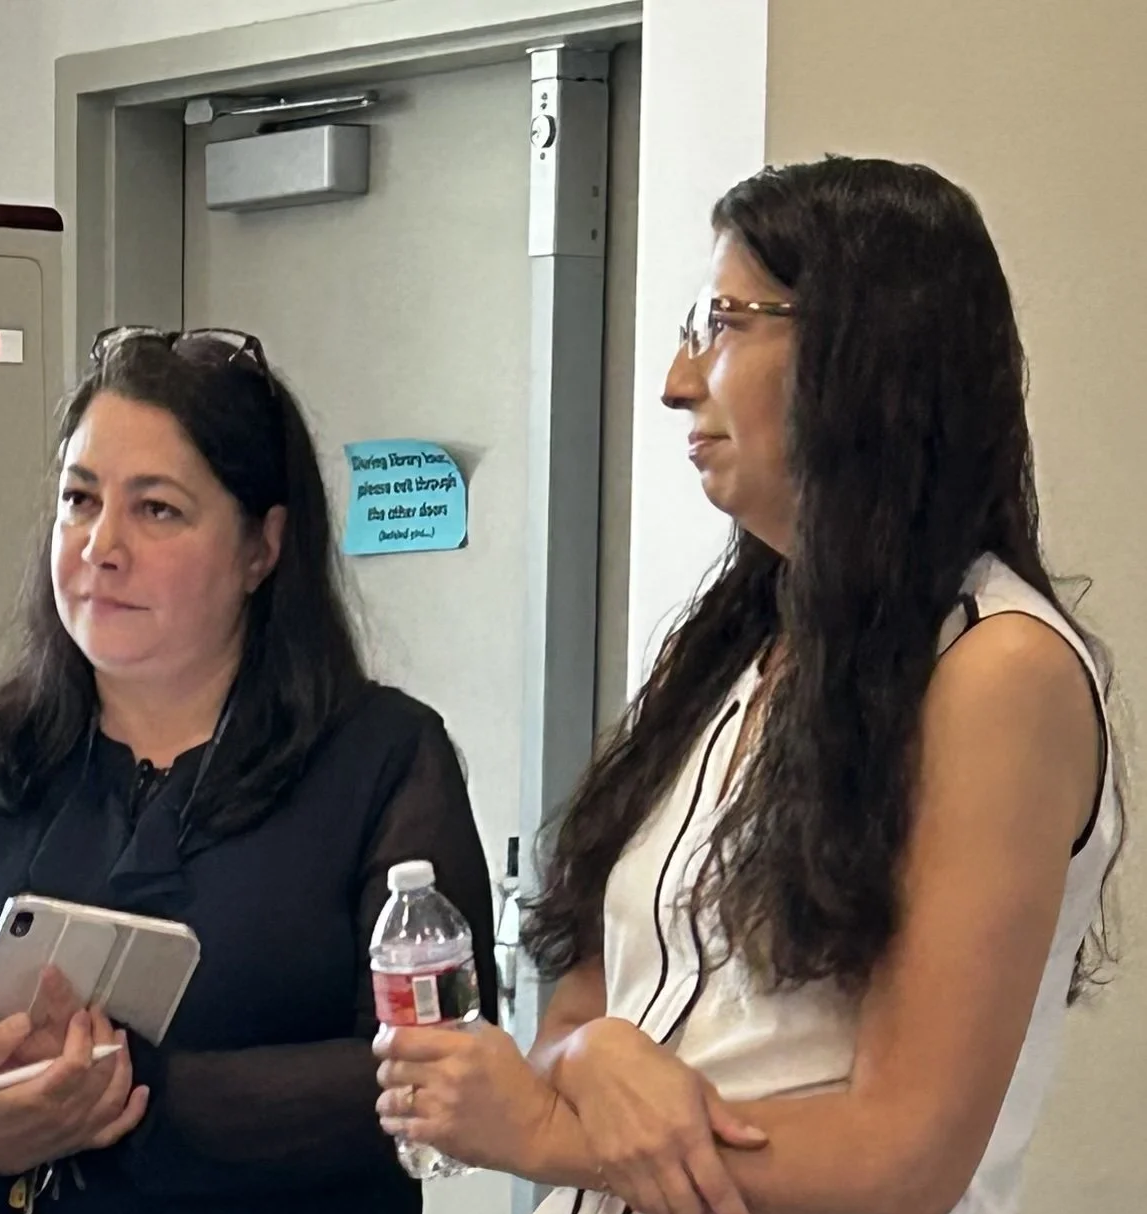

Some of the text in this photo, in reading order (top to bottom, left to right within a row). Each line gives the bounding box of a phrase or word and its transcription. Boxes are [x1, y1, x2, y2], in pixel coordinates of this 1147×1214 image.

[358, 472, 457, 500] please exit through
[367, 506, 385, 521] the
[388, 504, 417, 520] other
